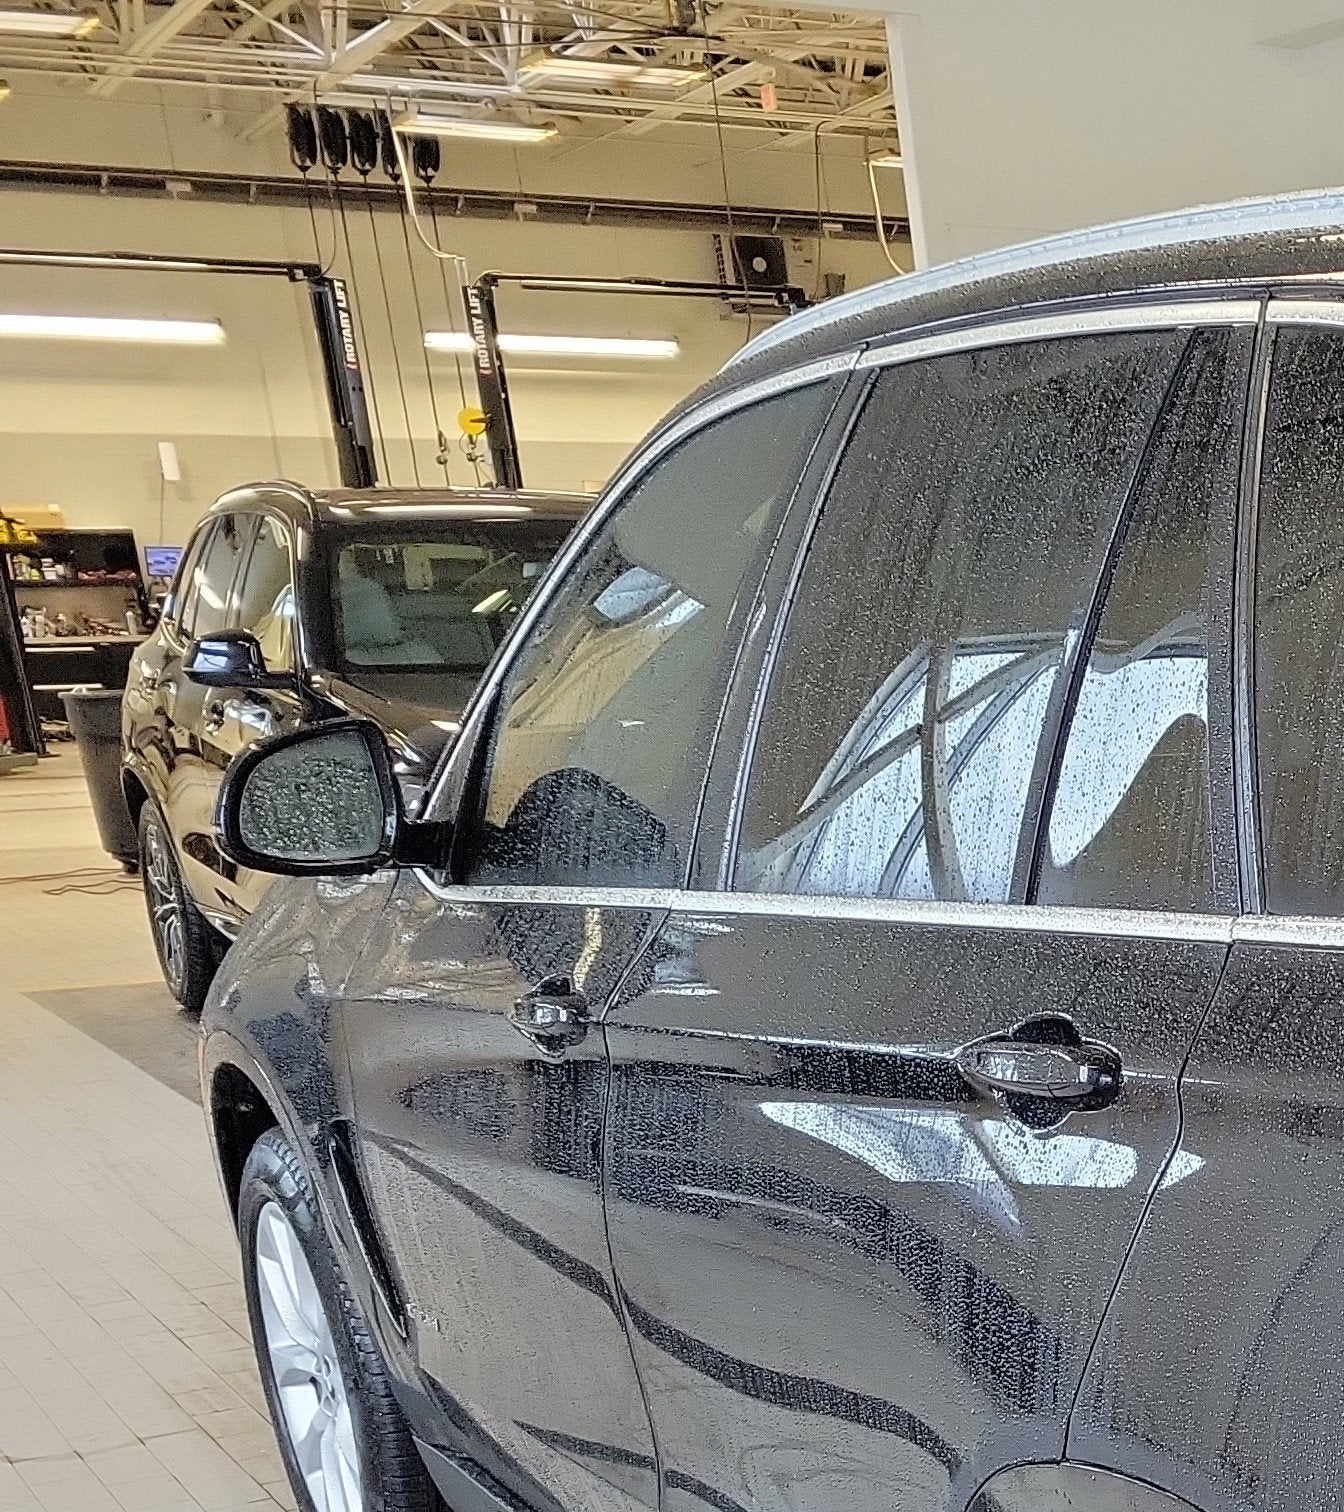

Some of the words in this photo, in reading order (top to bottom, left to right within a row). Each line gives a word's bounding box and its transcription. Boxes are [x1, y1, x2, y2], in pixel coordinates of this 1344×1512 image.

[333, 279, 348, 308] LIFT
[467, 287, 482, 315] LIFT
[339, 311, 357, 363] ROTARY
[471, 316, 491, 368] ROTARY
